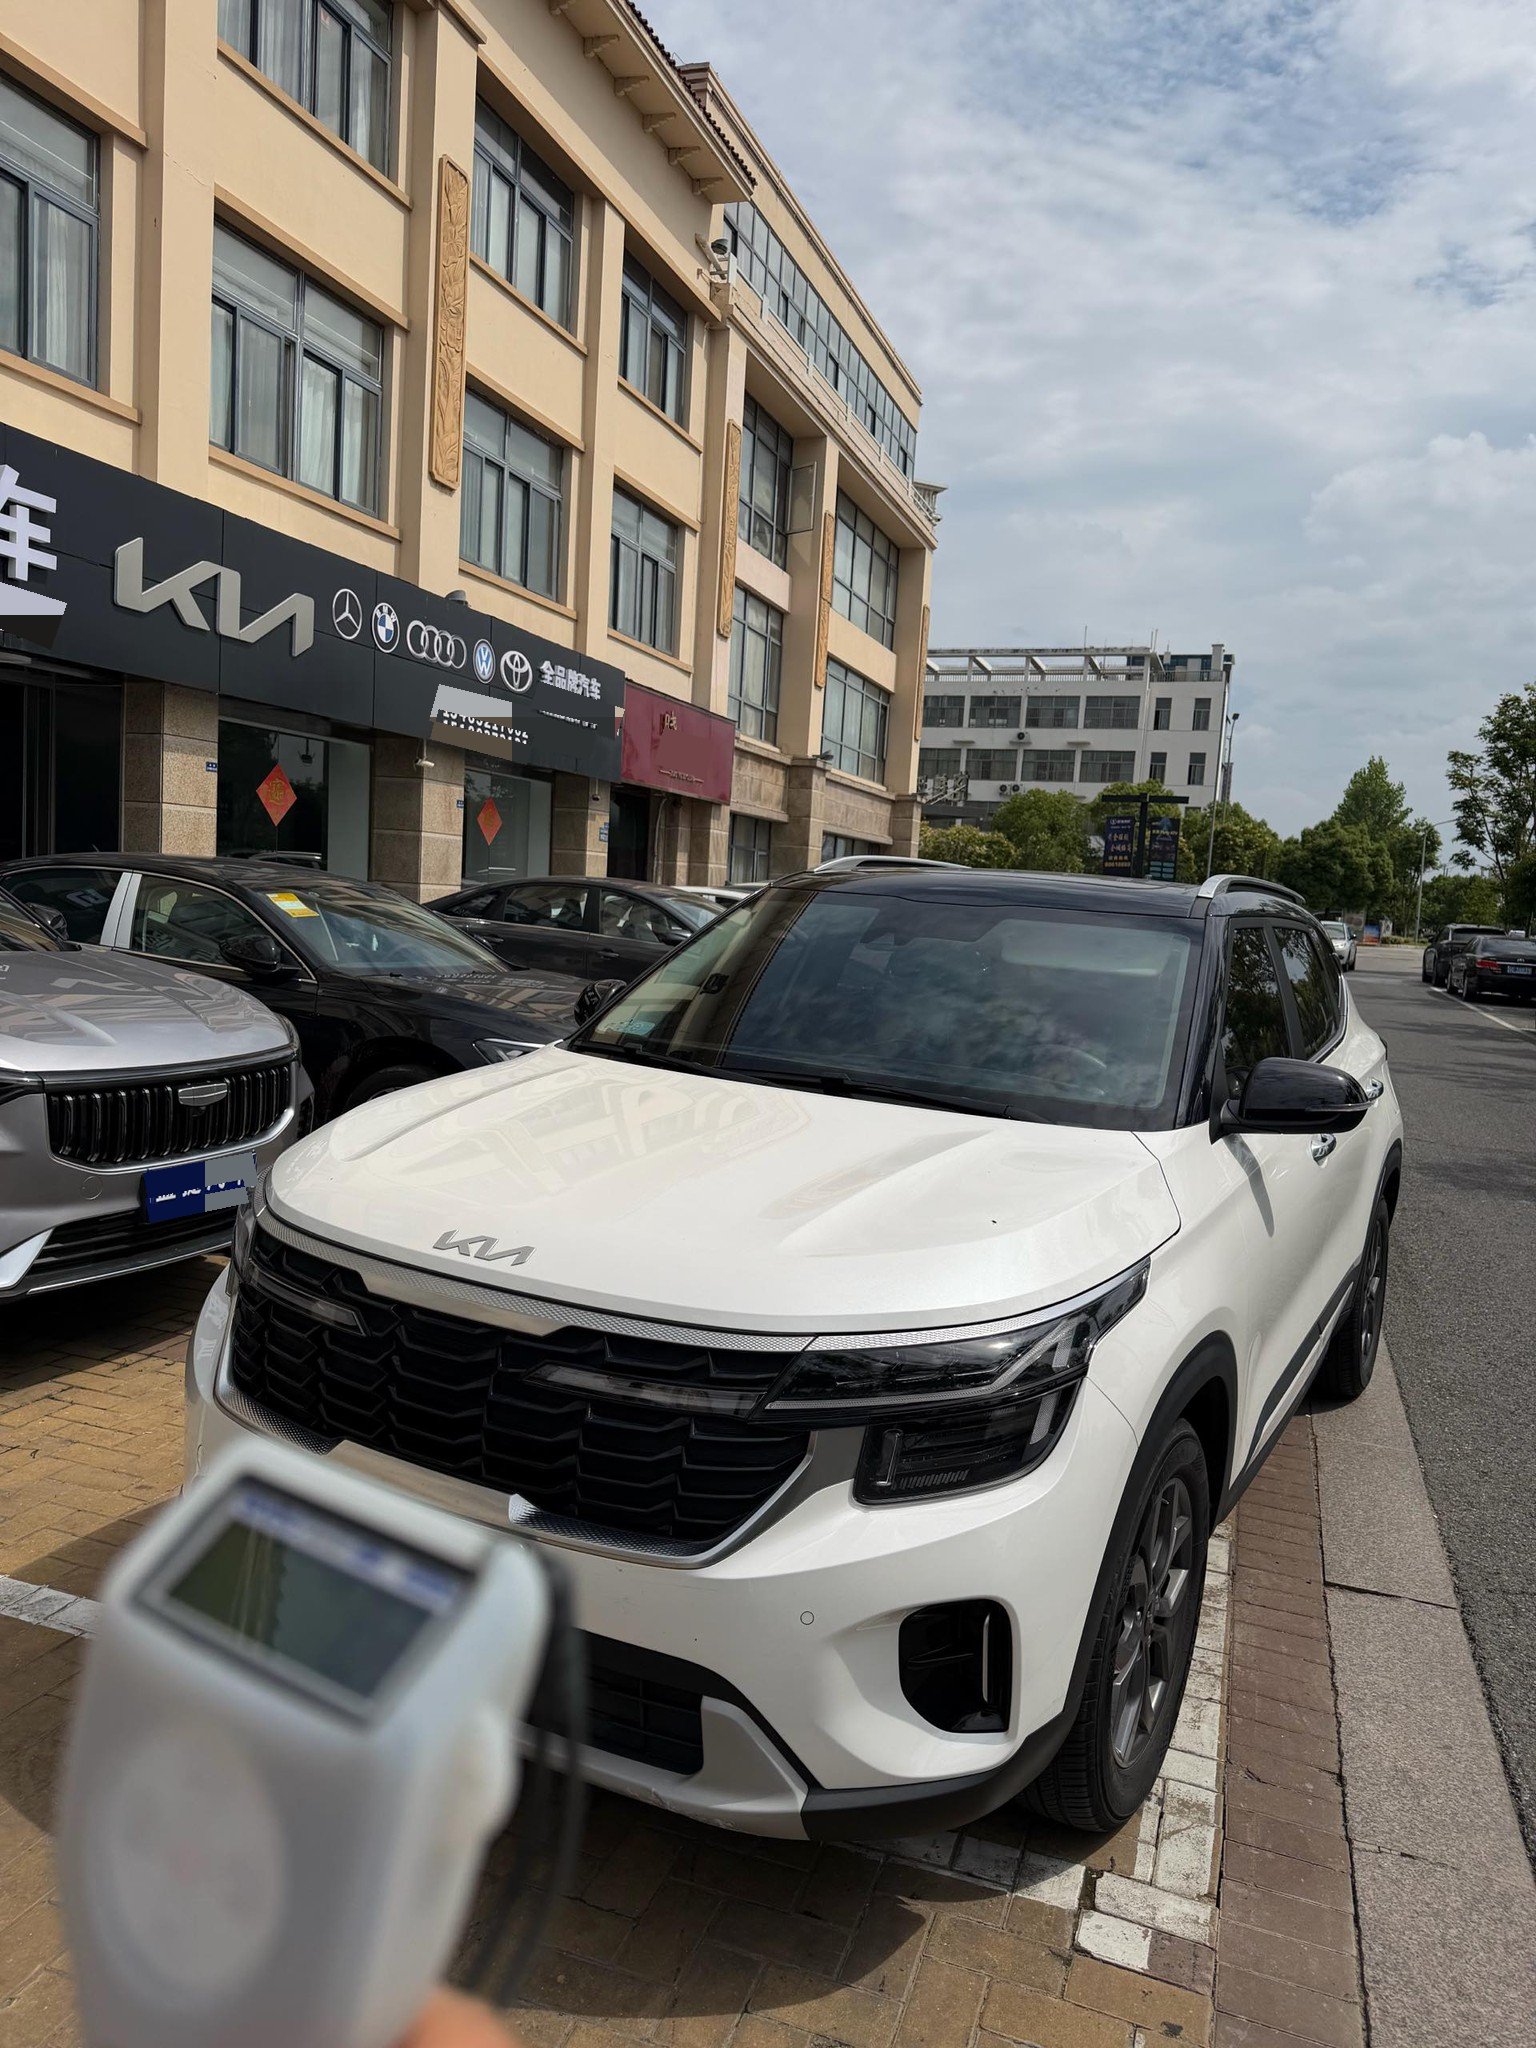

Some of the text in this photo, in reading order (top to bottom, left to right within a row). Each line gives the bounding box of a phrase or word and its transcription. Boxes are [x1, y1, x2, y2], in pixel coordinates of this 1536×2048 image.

[540, 660, 601, 700] 全品牌汽车
